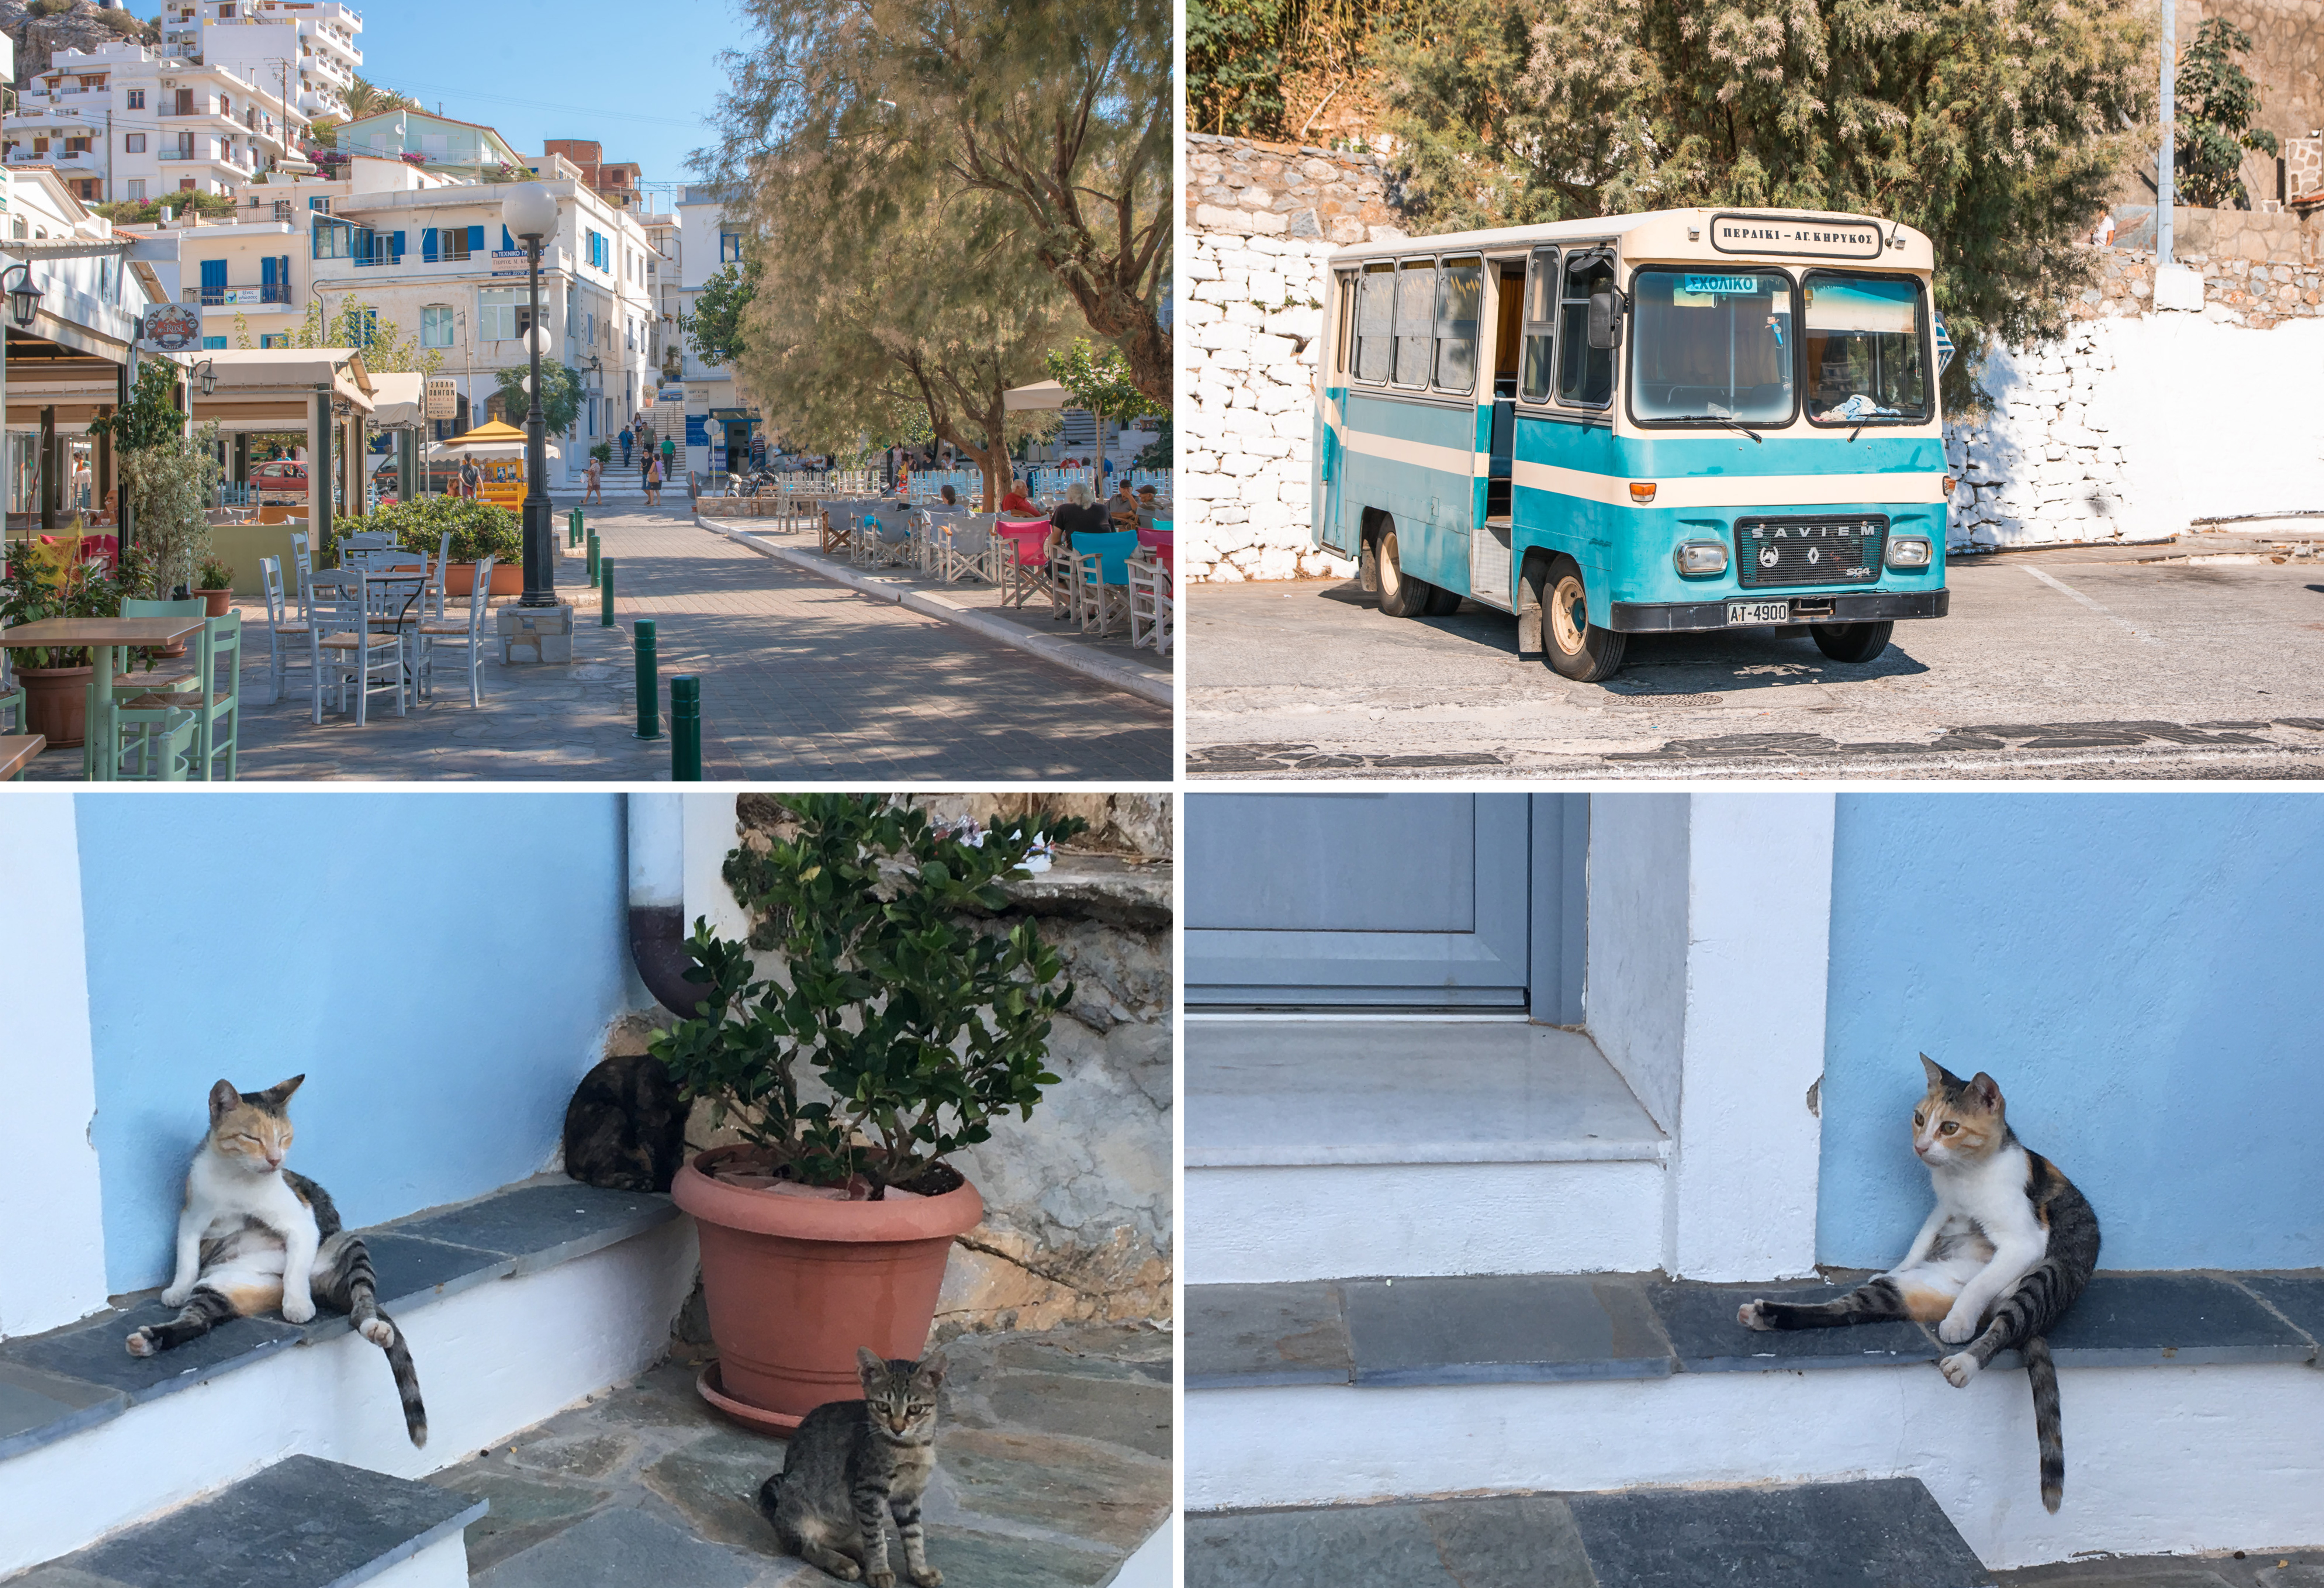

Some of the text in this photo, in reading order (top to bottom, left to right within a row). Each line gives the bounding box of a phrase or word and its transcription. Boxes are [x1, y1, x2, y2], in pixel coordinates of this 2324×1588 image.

[1723, 228, 1780, 239] ΠΕΡΔΙΚΙ
[1795, 231, 1810, 241] ΑΓ.
[1813, 232, 1872, 244] ΚΗΡΥΚΟΣ
[1690, 277, 1753, 290] ΣΧΟΛΙΚΟ
[164, 324, 185, 334] ROSE
[1751, 526, 1874, 538] SAVIEM
[1846, 568, 1870, 576] SG4
[1730, 605, 1787, 622] AT-4900
